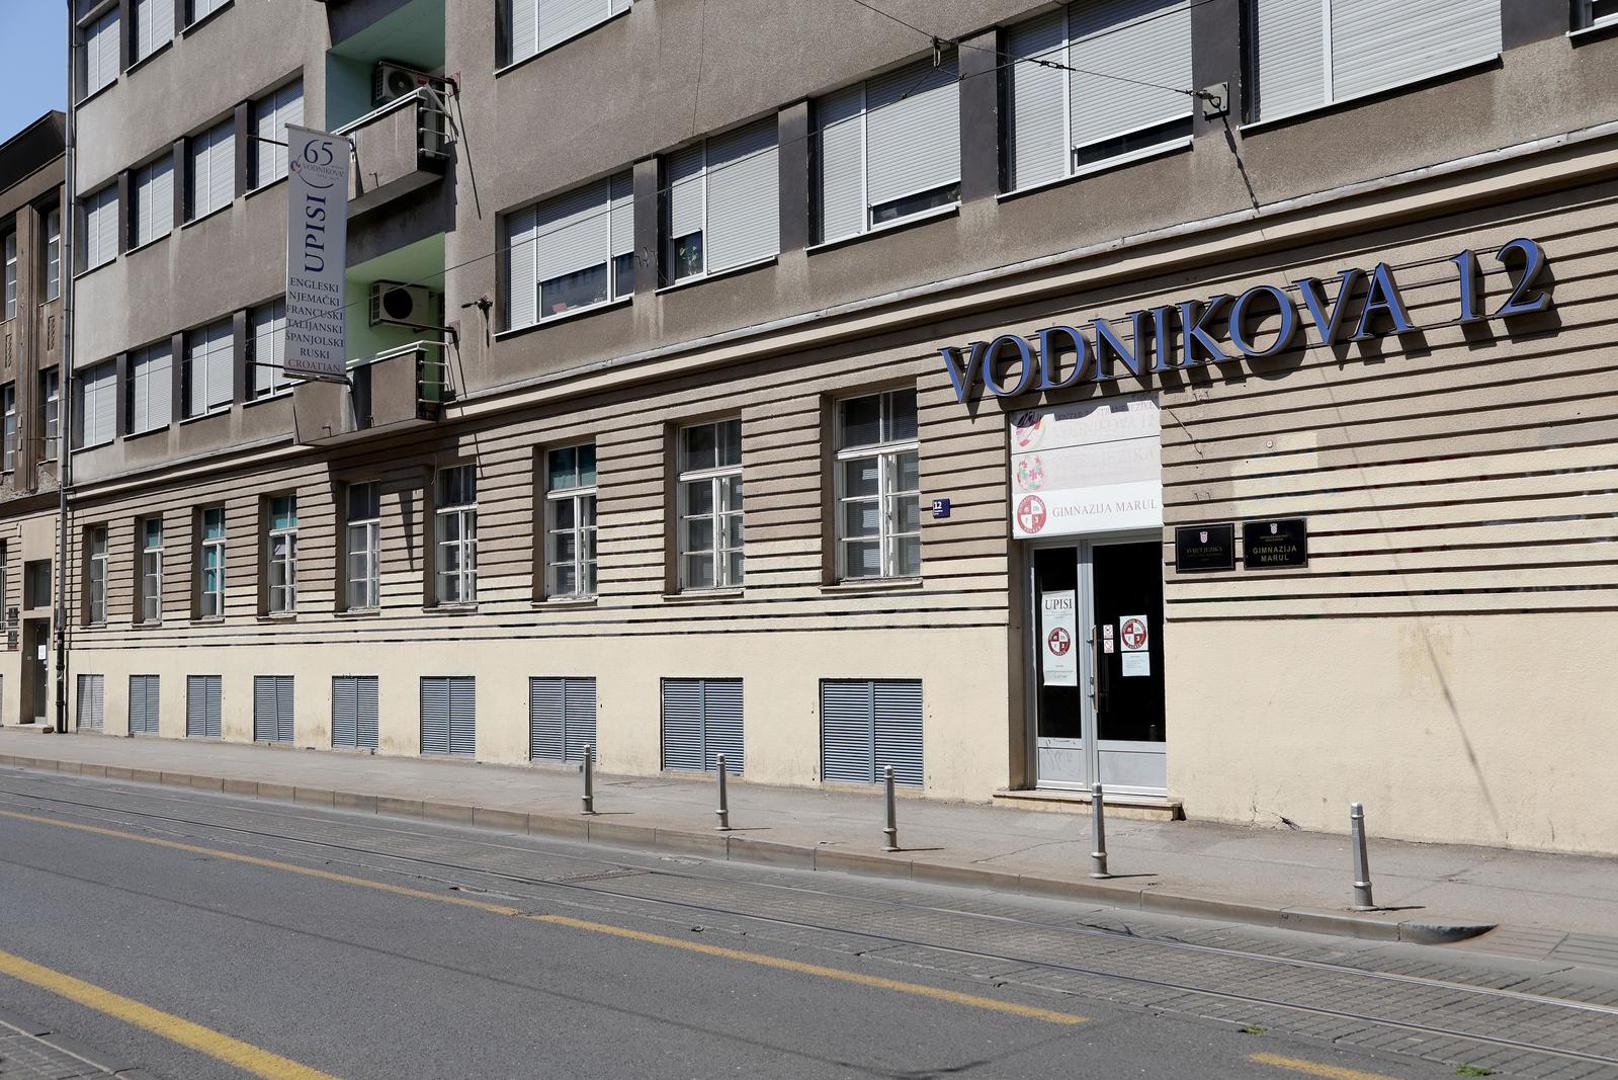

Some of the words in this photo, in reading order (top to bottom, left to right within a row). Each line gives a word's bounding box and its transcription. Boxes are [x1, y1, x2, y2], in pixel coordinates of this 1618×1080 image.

[304, 139, 333, 166] 65
[305, 194, 326, 273] UPISI
[290, 277, 339, 293] ENGLESKI
[289, 290, 340, 306] NJEMAČKI
[286, 304, 343, 320] FRANCUSKI
[286, 318, 342, 334] TALIJANSKI
[938, 261, 1420, 405] VODNIKOVA
[1450, 237, 1553, 325] 12
[285, 331, 344, 347] ŠPANJOLSKI
[299, 347, 330, 359] RUSKI
[288, 359, 341, 373] CROATIAN
[934, 501, 942, 509] 12
[1052, 502, 1112, 518] GIMNAZIJA
[1115, 499, 1159, 512] MARUL
[1252, 545, 1297, 555] GIMNAZIJA
[1260, 554, 1290, 563] MARUL
[1044, 598, 1073, 611] UPISI
